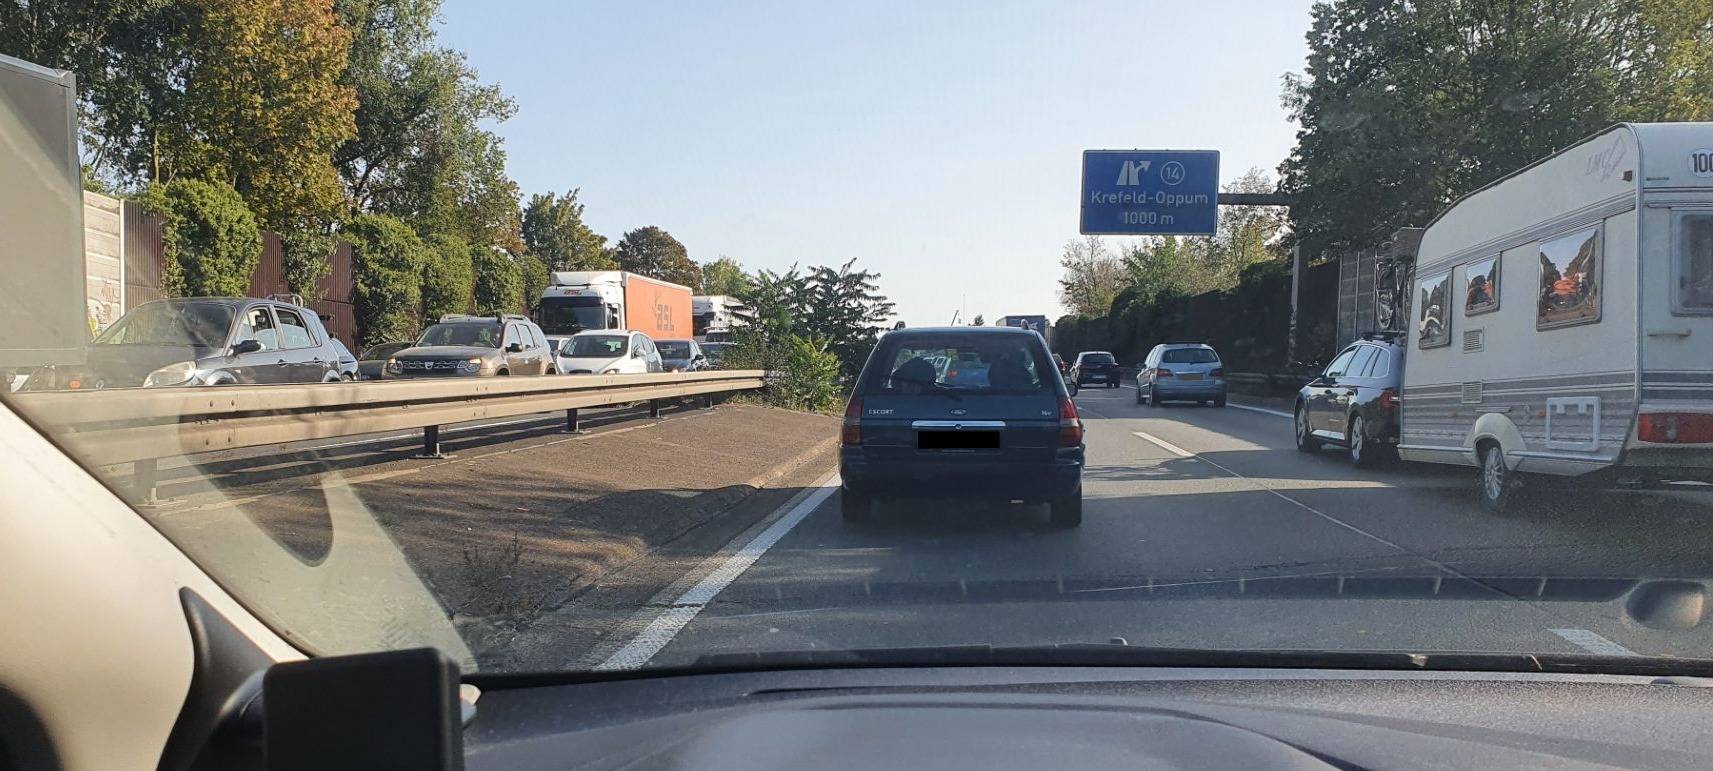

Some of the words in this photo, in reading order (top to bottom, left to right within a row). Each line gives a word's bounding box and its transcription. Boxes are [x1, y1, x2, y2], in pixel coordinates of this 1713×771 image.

[1165, 166, 1180, 180] 14
[1091, 190, 1208, 207] Krefeld-Oppum
[1124, 211, 1157, 225] 1000
[1160, 213, 1174, 225] m
